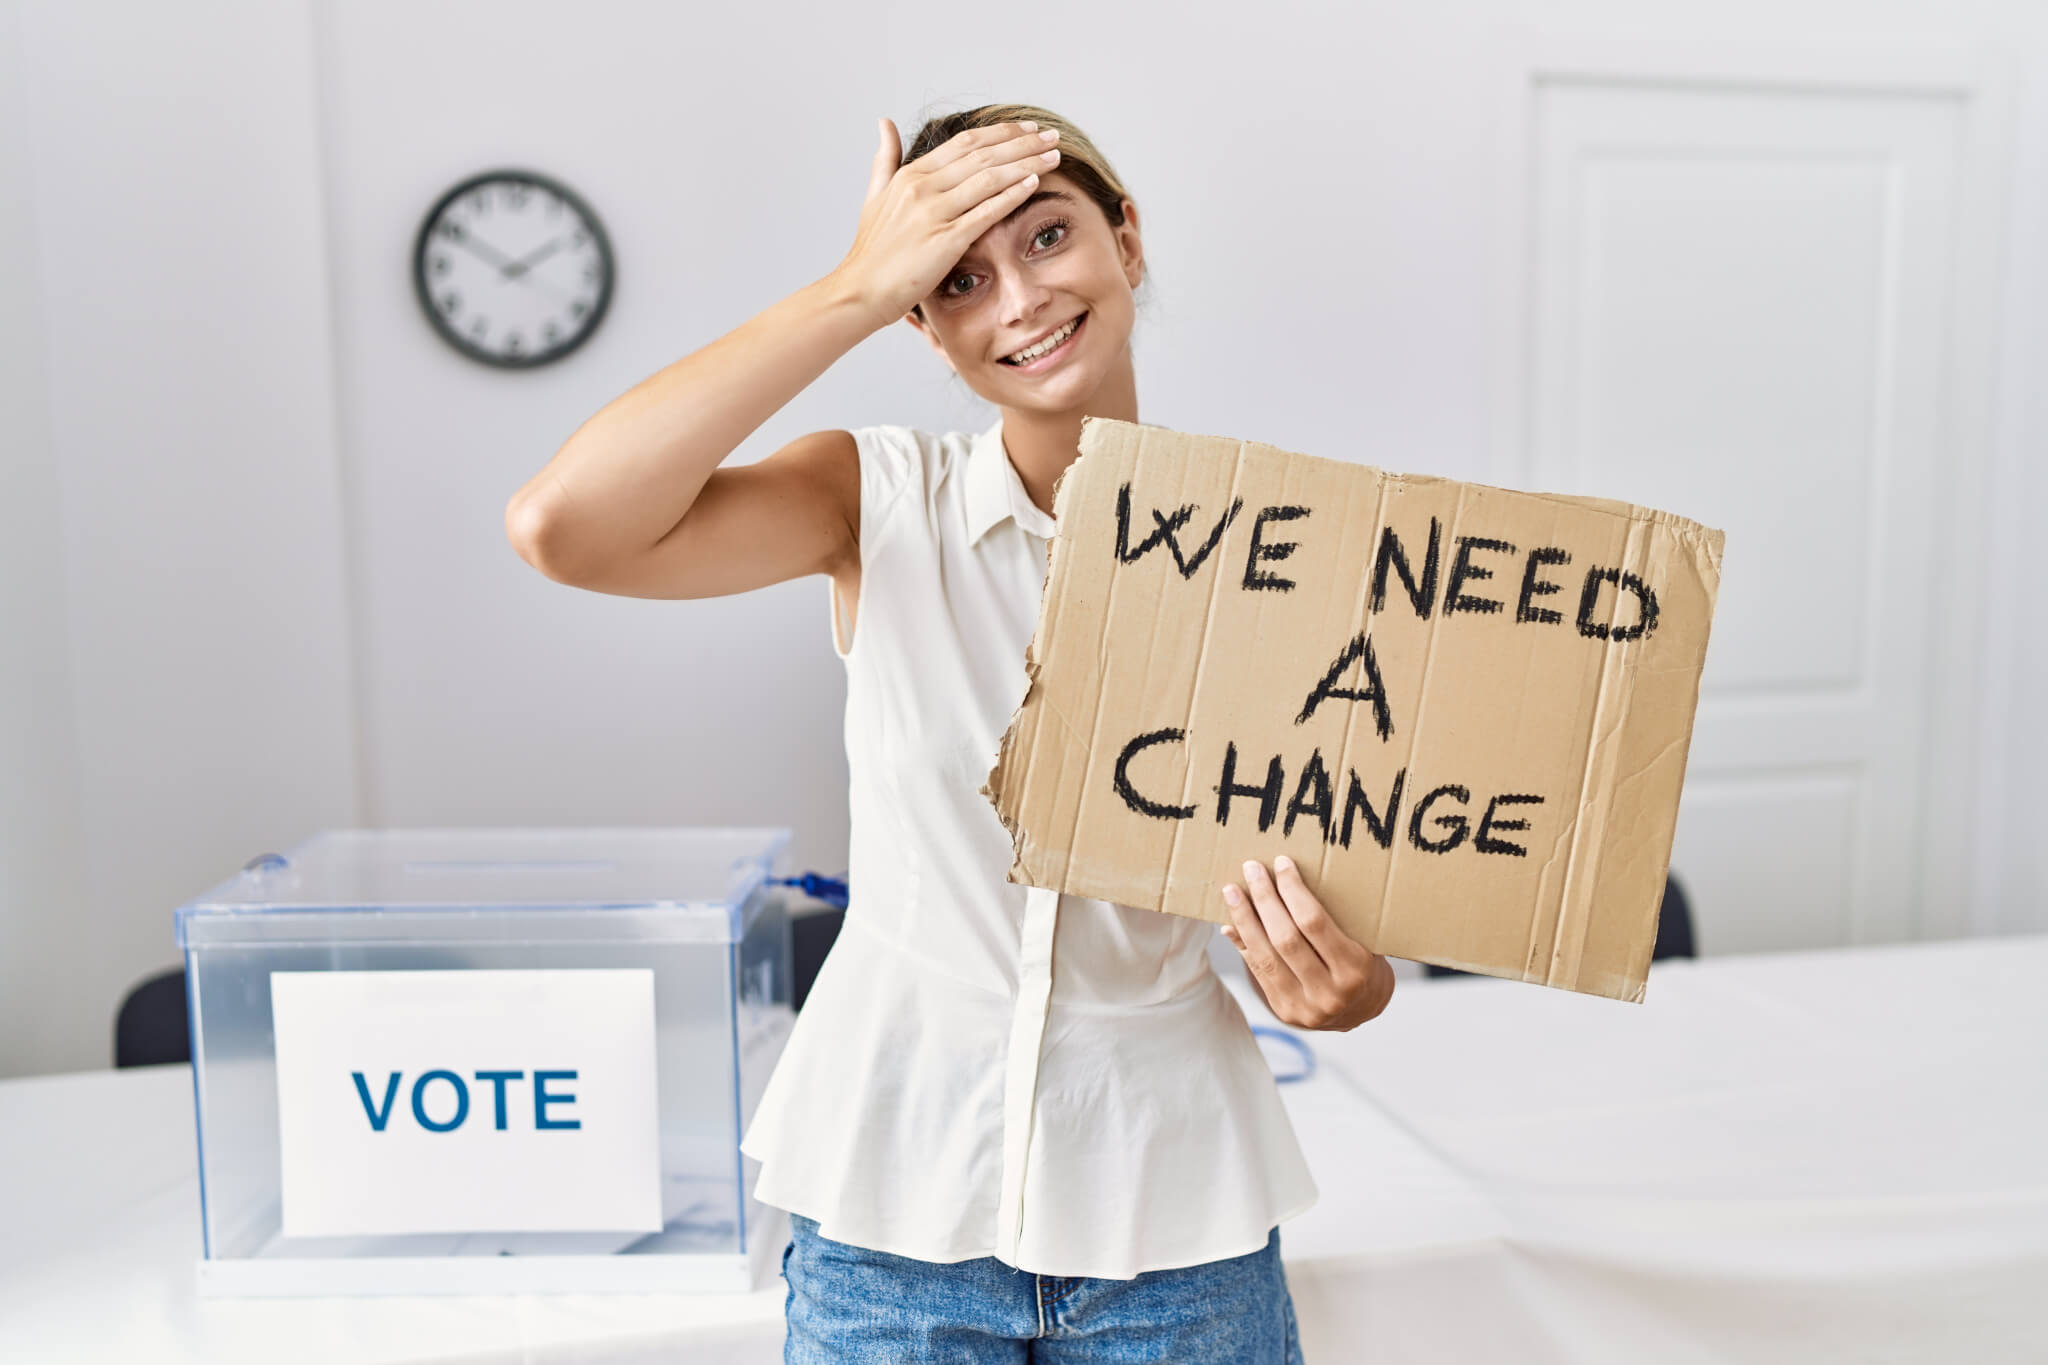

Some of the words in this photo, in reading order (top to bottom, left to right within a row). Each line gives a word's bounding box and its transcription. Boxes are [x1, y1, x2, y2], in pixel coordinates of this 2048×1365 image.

[1114, 481, 1311, 593] WE
[1367, 515, 1660, 643] NEED
[1294, 629, 1394, 743] A
[1112, 726, 1545, 858] CHANGE
[351, 1069, 582, 1133] VOTE
